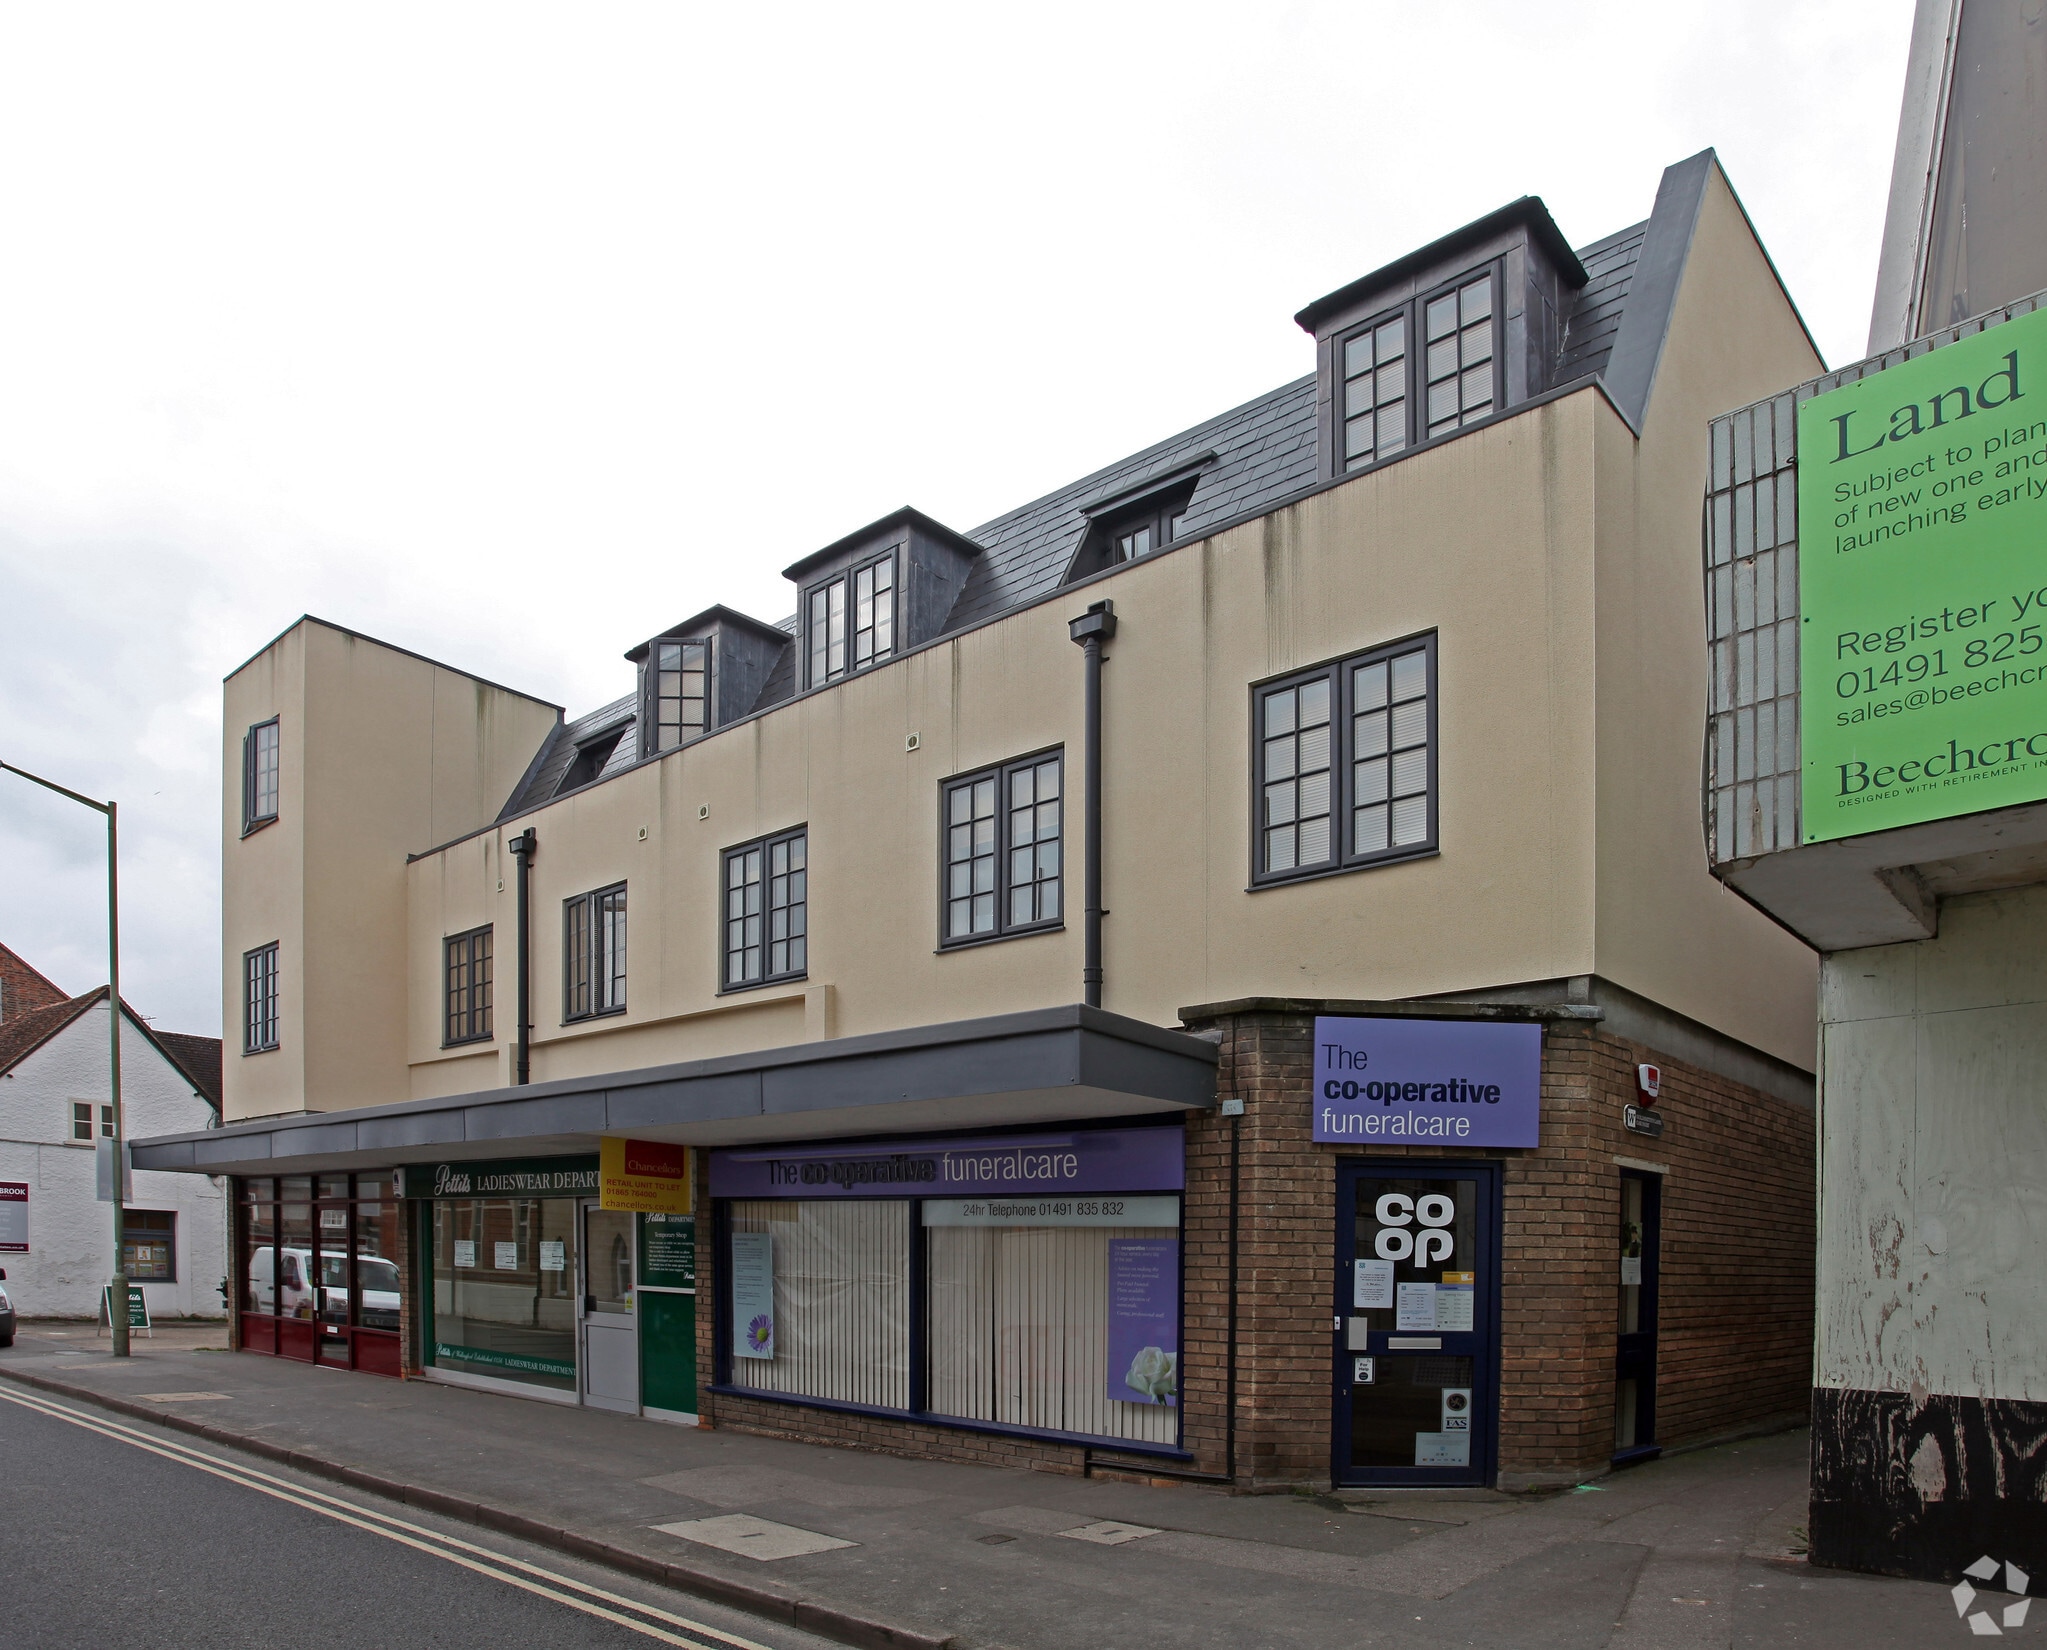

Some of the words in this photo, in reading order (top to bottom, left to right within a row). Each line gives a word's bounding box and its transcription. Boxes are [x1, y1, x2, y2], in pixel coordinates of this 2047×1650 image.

[1829, 349, 2026, 464] Land
[1834, 455, 1935, 502] Subject
[1945, 447, 1972, 466] to
[1984, 421, 2047, 459] plan
[1834, 504, 1858, 528] of
[1868, 489, 1922, 518] new
[1932, 470, 1984, 497] one
[1995, 443, 2047, 479] and
[1836, 502, 1967, 554] launching
[1977, 477, 2047, 511] early
[1837, 600, 1997, 660] Register
[1836, 649, 1949, 699] 01491
[1838, 789, 1900, 808] DESIGNED
[1905, 782, 1937, 794] WITH
[1943, 763, 2028, 787] RETIREMENT
[1321, 1044, 1368, 1071] The
[1323, 1078, 1501, 1106] co-operative
[1321, 1108, 1471, 1137] funeralcare
[434, 1164, 471, 1196] Pettits
[477, 1173, 550, 1191] LADIESWEAR
[628, 1160, 680, 1174] Chancellors
[769, 1159, 798, 1185] The
[800, 1155, 936, 1189] co-operative
[942, 1149, 1078, 1181] funeralcare
[606, 1179, 633, 1187] RETAIL
[635, 1181, 652, 1189] UNIT
[655, 1182, 665, 1190] TO
[606, 1188, 629, 1196] 01865
[605, 1200, 677, 1211] chancellors.co.uk
[963, 1204, 985, 1217] 24hr
[987, 1203, 1036, 1219] Telephone
[1039, 1203, 1073, 1217] 01491
[1076, 1202, 1098, 1216] 835
[1102, 1201, 1124, 1216] 832
[504, 1358, 538, 1371] LADIESWEAR
[539, 1363, 576, 1376] DEPARTMENT
